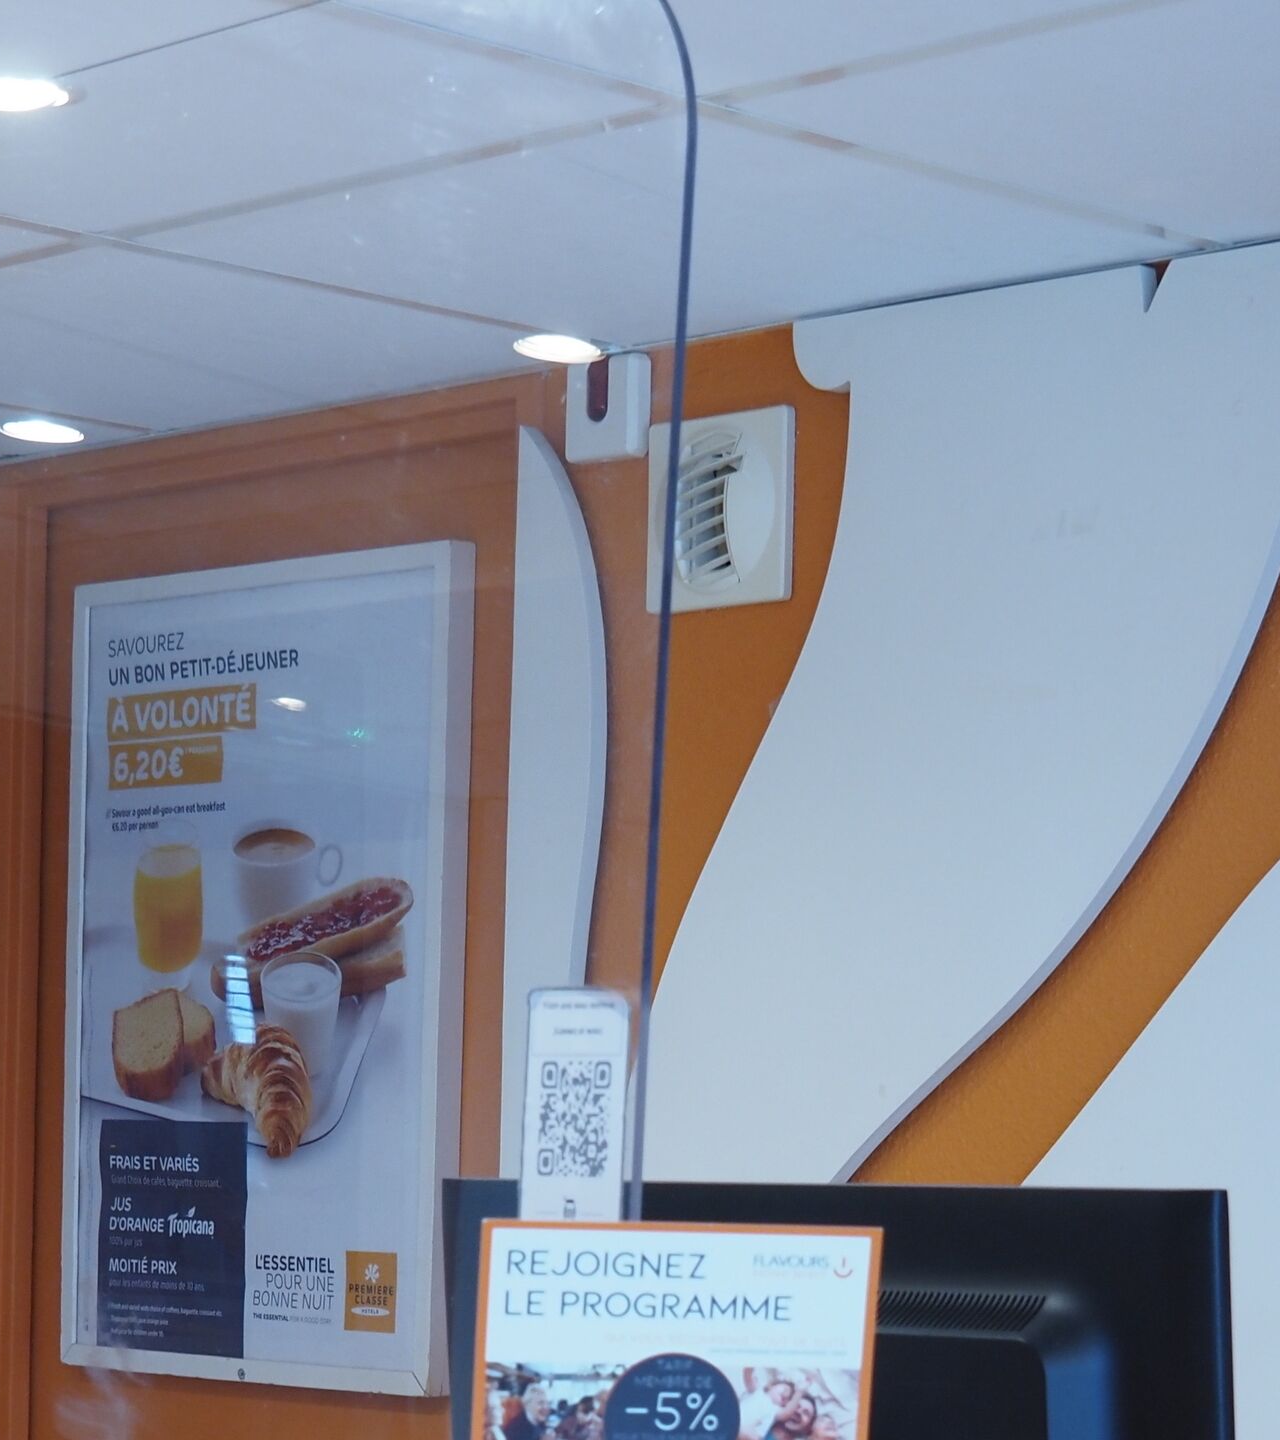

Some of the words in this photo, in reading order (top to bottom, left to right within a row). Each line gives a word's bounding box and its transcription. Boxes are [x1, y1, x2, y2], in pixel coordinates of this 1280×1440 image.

[107, 631, 185, 659] SAVOUREZ
[108, 666, 130, 687] UN
[134, 663, 166, 685] BON
[170, 648, 299, 681] PETIT-DÉJEUNER
[111, 698, 129, 734] À
[134, 683, 252, 733] VOLONTÉ
[114, 746, 185, 786] 6,20€
[111, 807, 132, 819] Savour
[132, 809, 136, 817] a
[136, 805, 152, 819] good
[152, 804, 185, 818] all-you-can
[185, 804, 197, 814] eat
[197, 801, 226, 813] breakfast
[128, 822, 138, 832] per
[139, 821, 159, 832] person
[109, 1155, 142, 1170] FRAIS
[143, 1156, 158, 1170] ET
[160, 1153, 200, 1172] VARIÉS
[110, 1197, 132, 1212] JUS
[109, 1216, 165, 1234] D'ORANGE
[167, 1212, 216, 1239] Tropicana
[133, 1238, 143, 1248] jus
[108, 1255, 148, 1274] MOITIÉ
[151, 1260, 178, 1275] PRIX
[255, 1253, 335, 1274] L'ESSENTIEL
[506, 1249, 707, 1280] REJOIGNEZ
[753, 1254, 830, 1269] FLAVOURS
[123, 1279, 131, 1288] les
[131, 1279, 152, 1289] enfants
[152, 1279, 160, 1289] de
[160, 1281, 178, 1290] moins
[178, 1281, 186, 1290] de
[266, 1272, 302, 1291] POUR
[306, 1275, 335, 1293] UNE
[253, 1289, 299, 1310] BONNE
[302, 1294, 335, 1312] NUIT
[354, 1295, 388, 1306] CLASSE
[504, 1289, 545, 1316] LE
[560, 1292, 793, 1322] PROGRAMME
[253, 1312, 262, 1320] THE
[263, 1313, 289, 1322] ESSENTIAL
[625, 1391, 719, 1431] -5%
